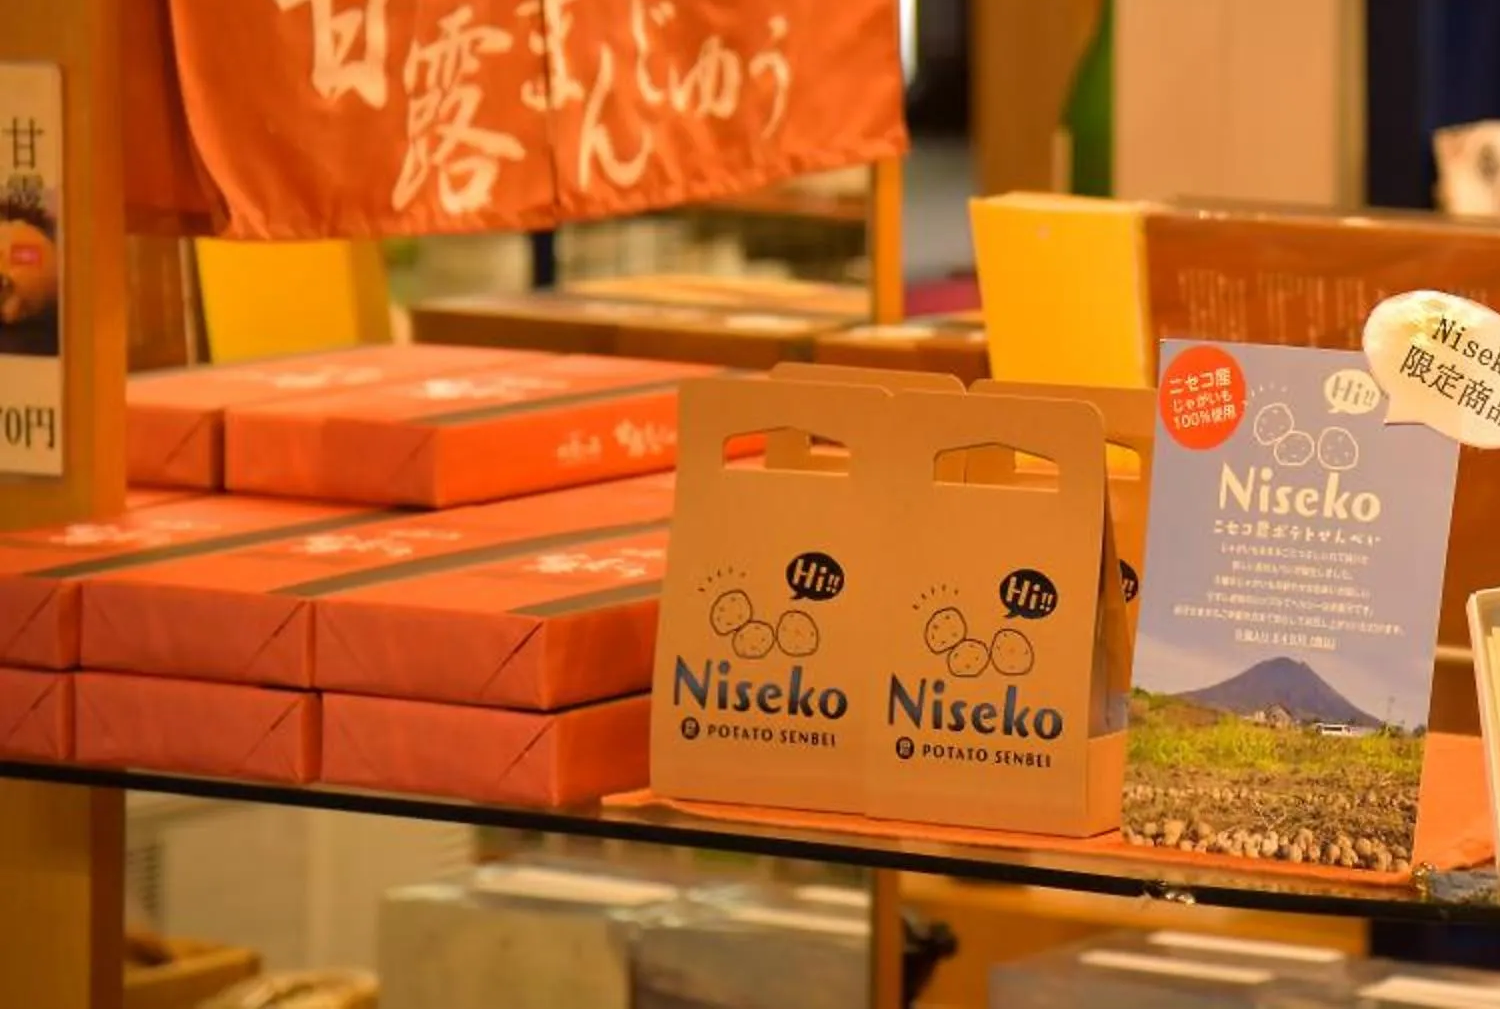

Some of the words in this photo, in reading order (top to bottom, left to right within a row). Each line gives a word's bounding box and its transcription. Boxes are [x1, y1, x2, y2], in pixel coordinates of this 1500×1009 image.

[1169, 367, 1231, 395] ニセコ産
[1173, 390, 1233, 413] じゃがいも
[1173, 404, 1236, 429] 100%使用
[0, 404, 56, 451] 0円
[1218, 461, 1382, 523] Niseko
[791, 558, 841, 593] Hi!!
[1005, 575, 1054, 612] Hi!!
[673, 654, 849, 720] Niseko
[887, 671, 1063, 740] Niseko
[707, 724, 774, 742] POTATO
[779, 729, 836, 748] SENBEI
[922, 743, 989, 763] POTATO
[994, 750, 1052, 768] SENBEI
